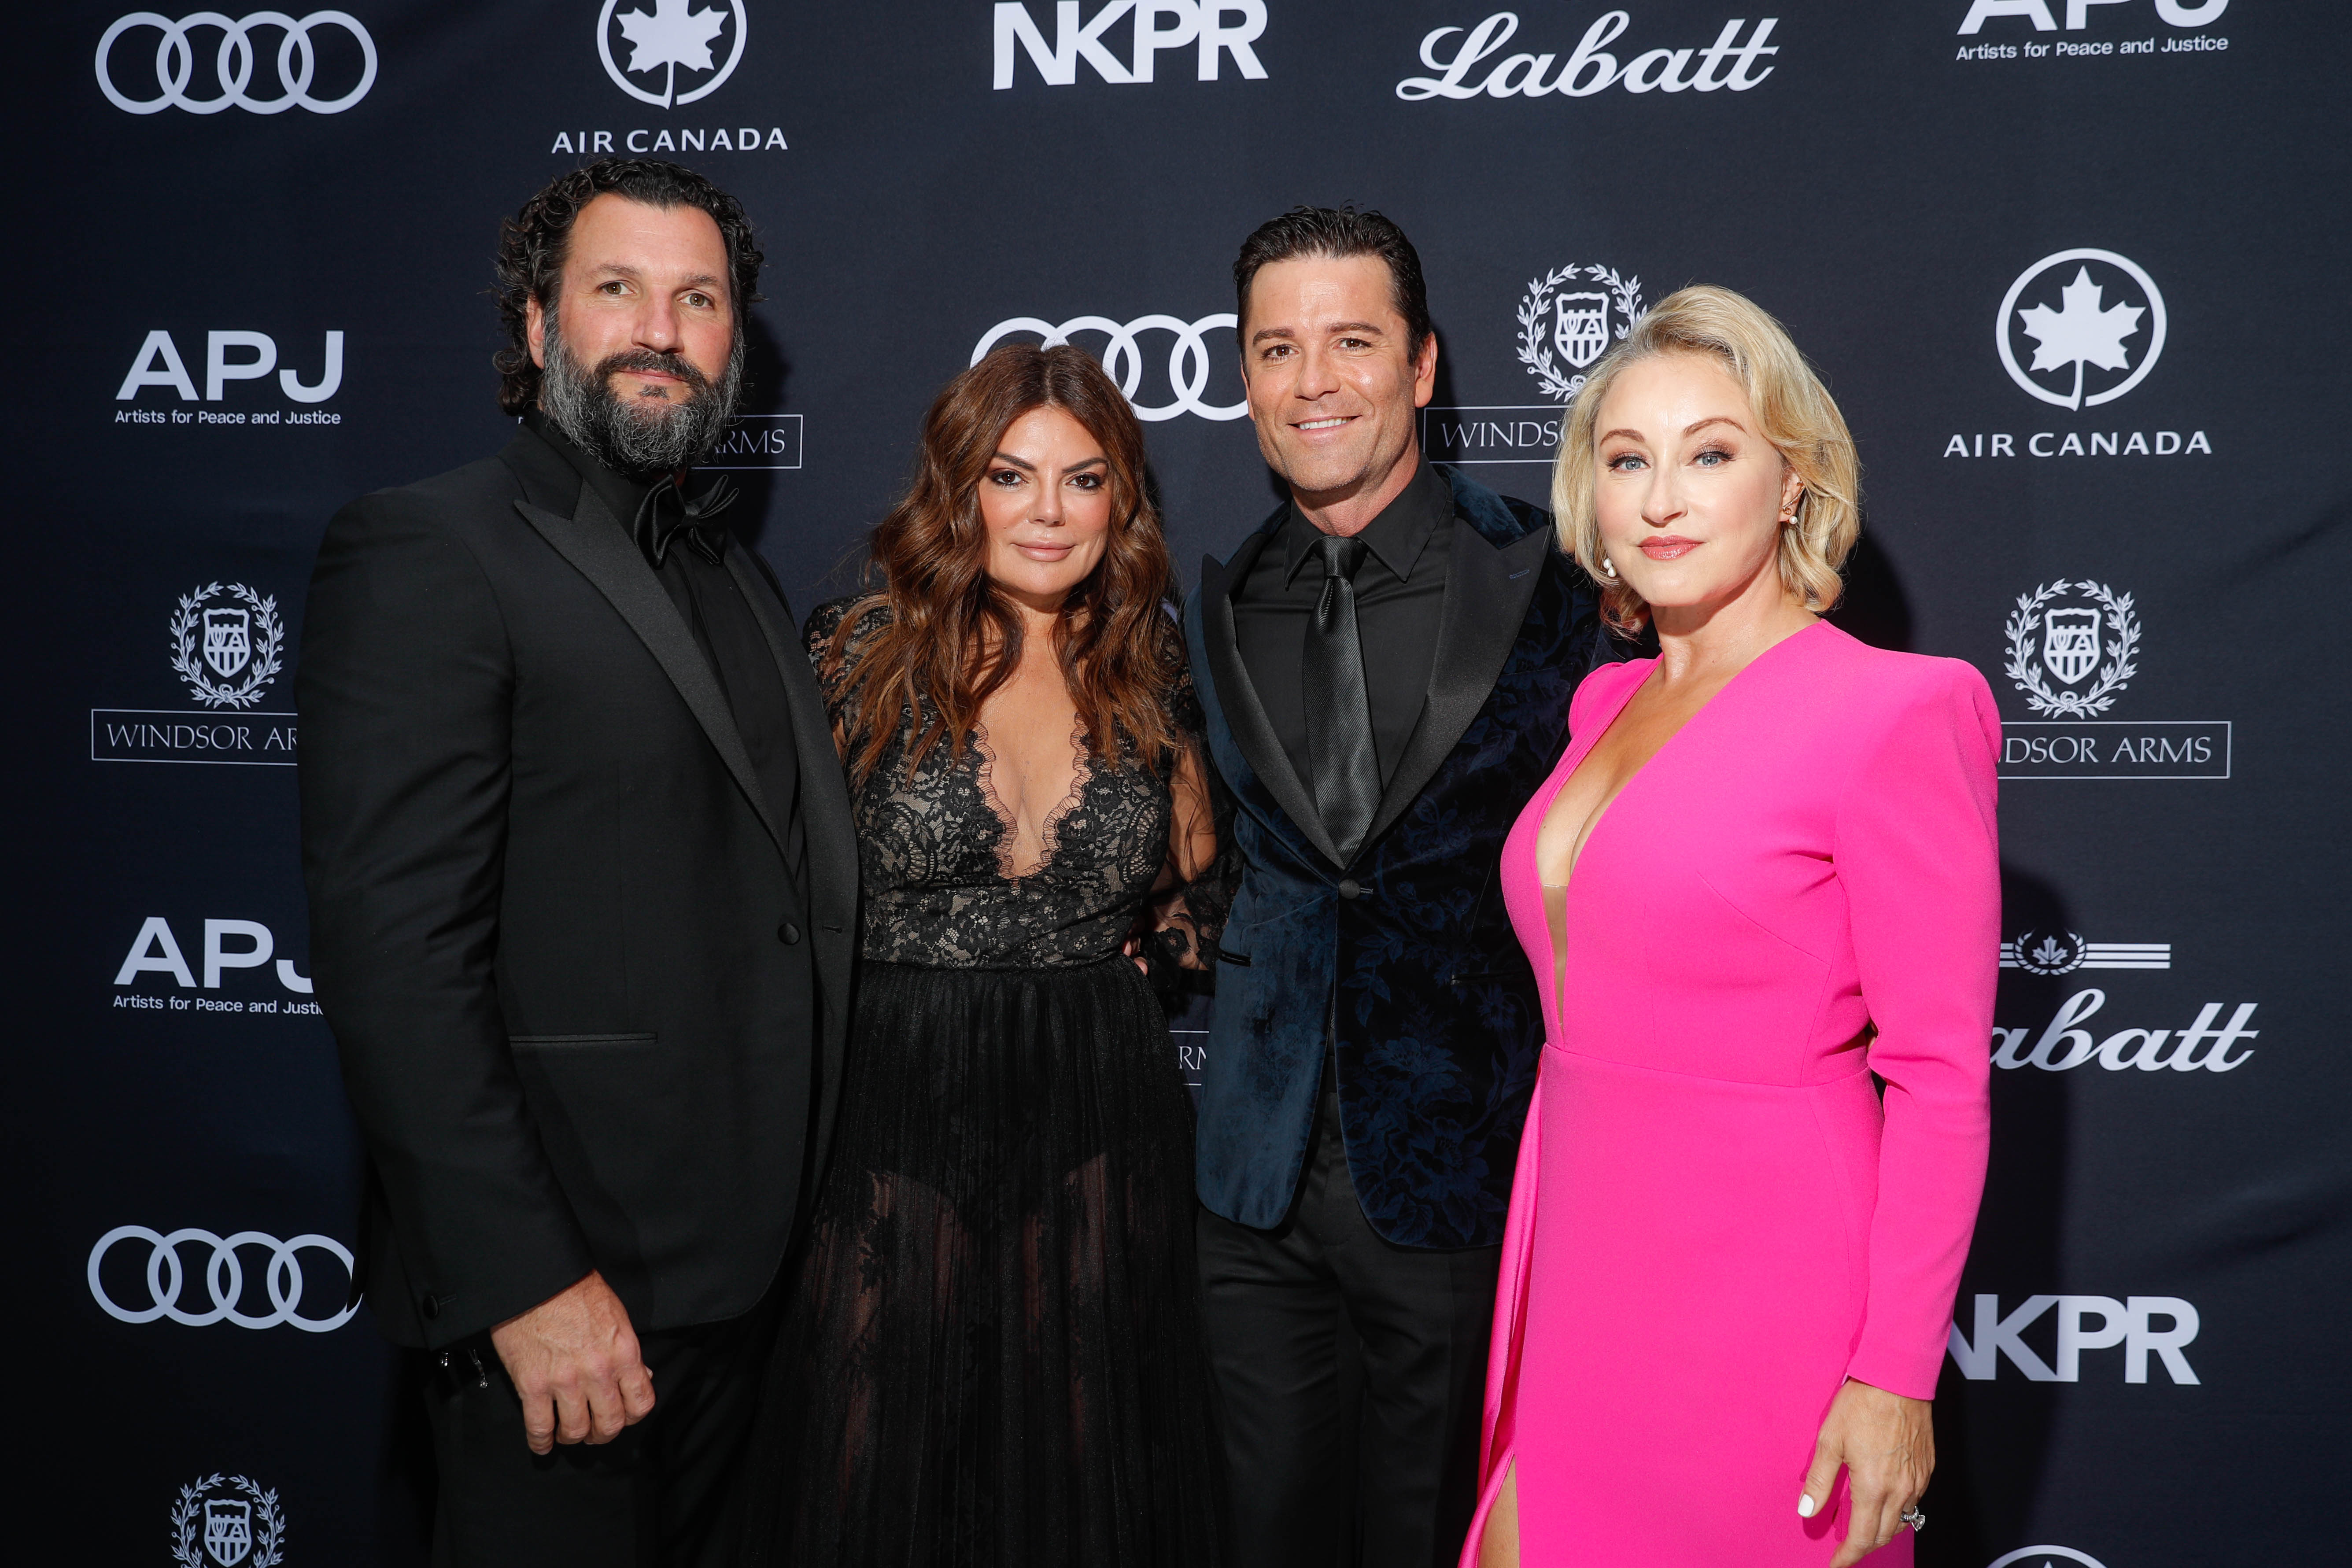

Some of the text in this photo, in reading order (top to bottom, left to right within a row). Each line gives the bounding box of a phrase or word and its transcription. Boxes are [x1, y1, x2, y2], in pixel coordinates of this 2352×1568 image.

[993, 0, 1269, 90] NKPR
[1396, 10, 1780, 101] Labatt
[1956, 34, 2229, 61] Artists for Peace and Justice
[551, 128, 788, 153] AIR CANADA
[116, 330, 344, 403] APJ
[115, 409, 341, 424] Artists for Peace and Justice
[715, 429, 785, 454] RMS
[1442, 420, 1566, 448] WINDS
[1943, 431, 2212, 457] AIR CANADA
[107, 723, 253, 750] WINDSOR
[1998, 736, 2212, 764] DSOR ARMS
[113, 994, 163, 1009] Artists
[169, 996, 191, 1010] for
[196, 998, 244, 1012] Peace
[249, 1000, 277, 1013] and
